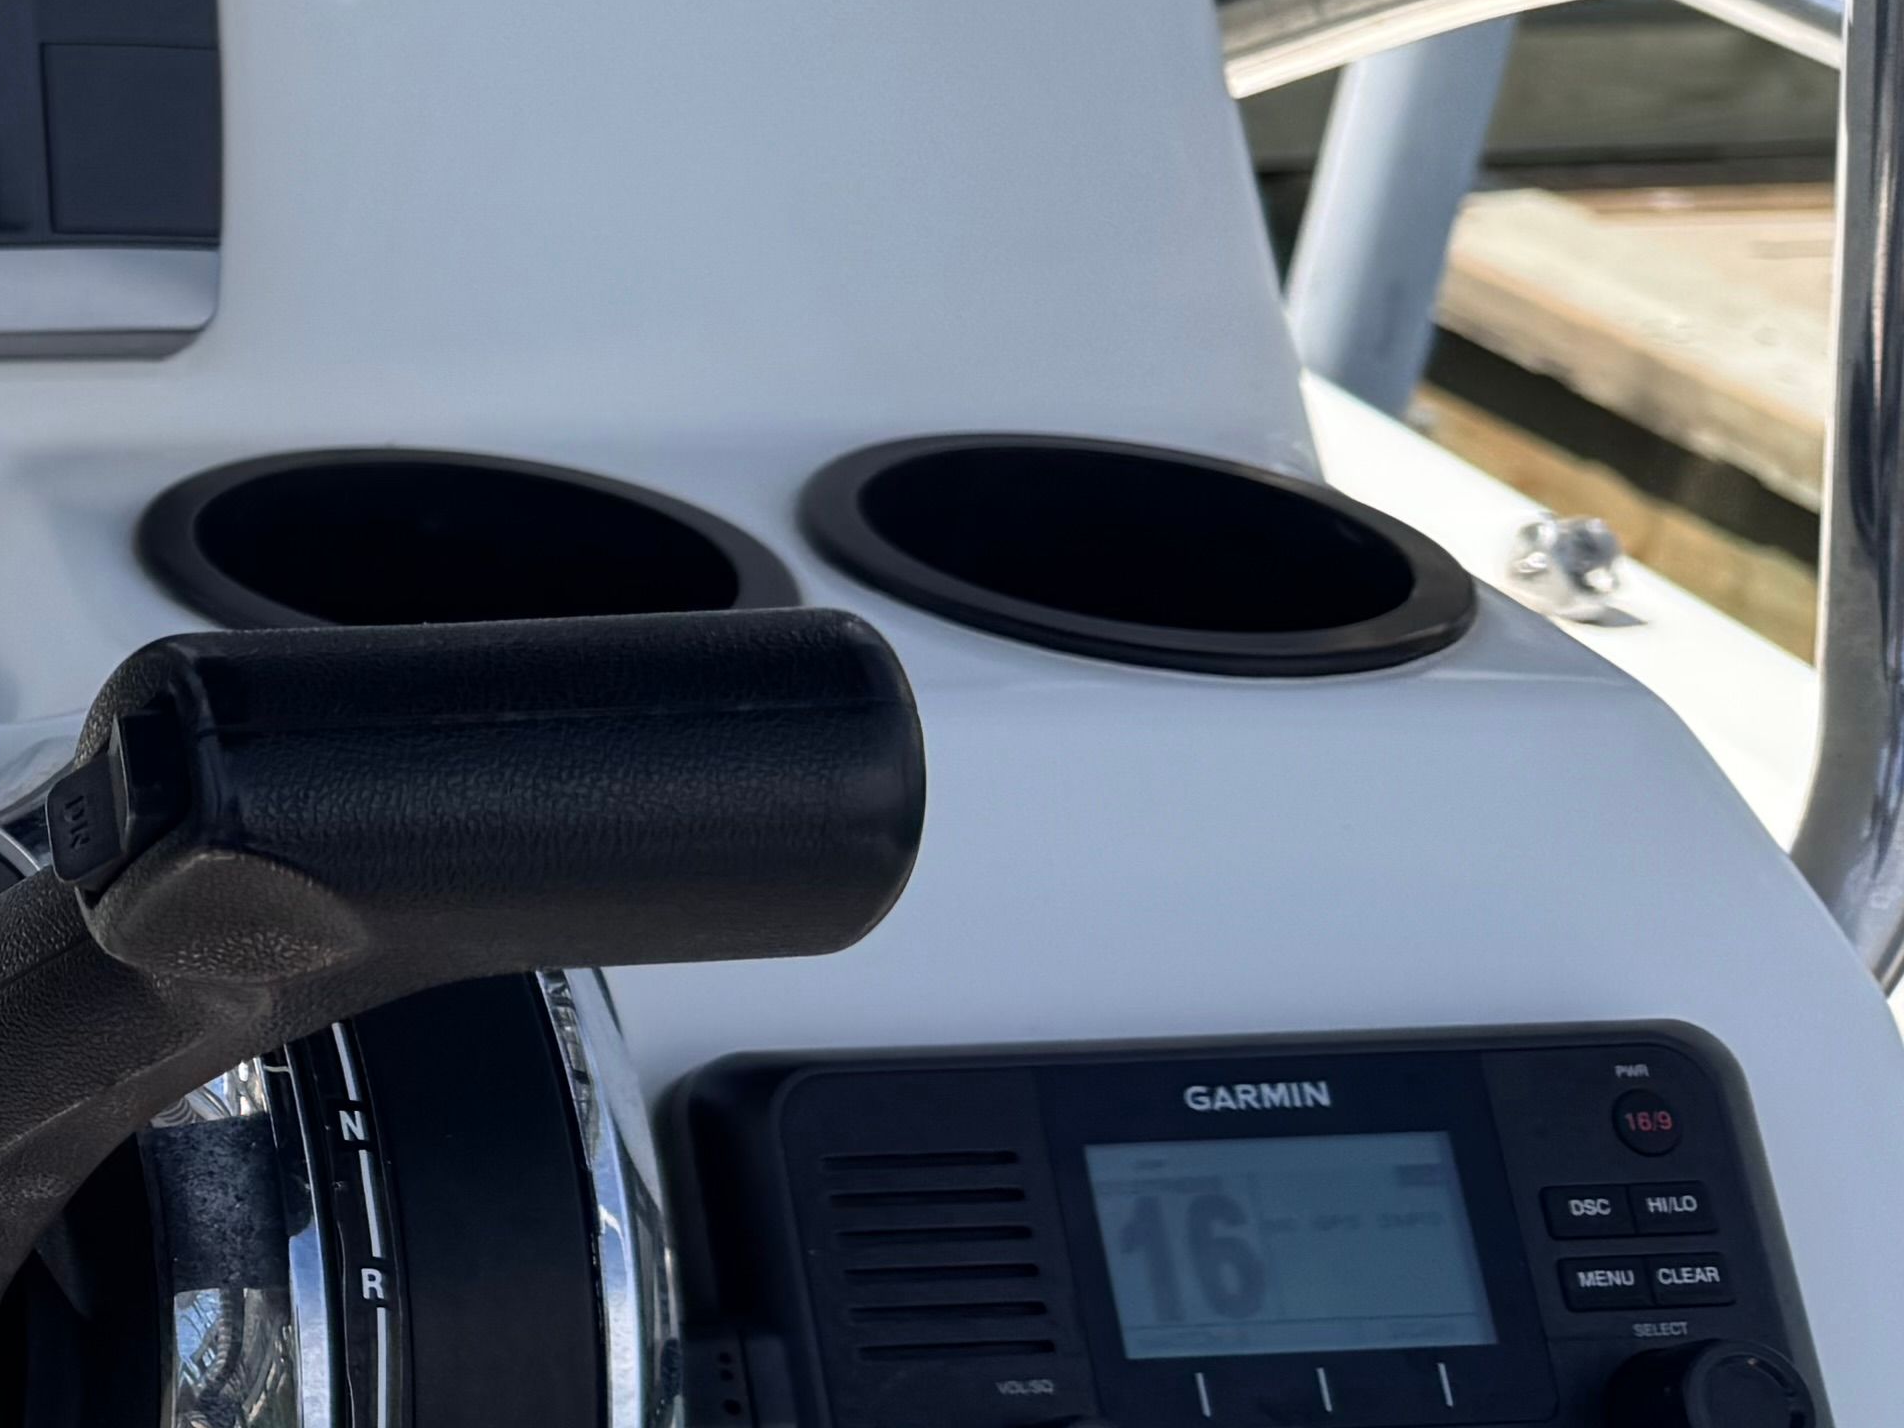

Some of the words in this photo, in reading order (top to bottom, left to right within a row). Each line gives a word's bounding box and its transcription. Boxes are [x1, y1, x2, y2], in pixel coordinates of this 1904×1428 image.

[1615, 1063, 1650, 1077] PWR
[1182, 1080, 1332, 1112] GARMIN
[338, 1109, 366, 1142] N
[1624, 1110, 1674, 1132] 16/9
[1568, 1197, 1612, 1217] DSC
[1645, 1194, 1699, 1214] HI/LO
[1119, 1191, 1266, 1324] 16
[360, 1267, 386, 1301] R
[1576, 1269, 1636, 1288] MENU
[1656, 1266, 1722, 1286] CLEAR
[1632, 1320, 1689, 1338] SELECT
